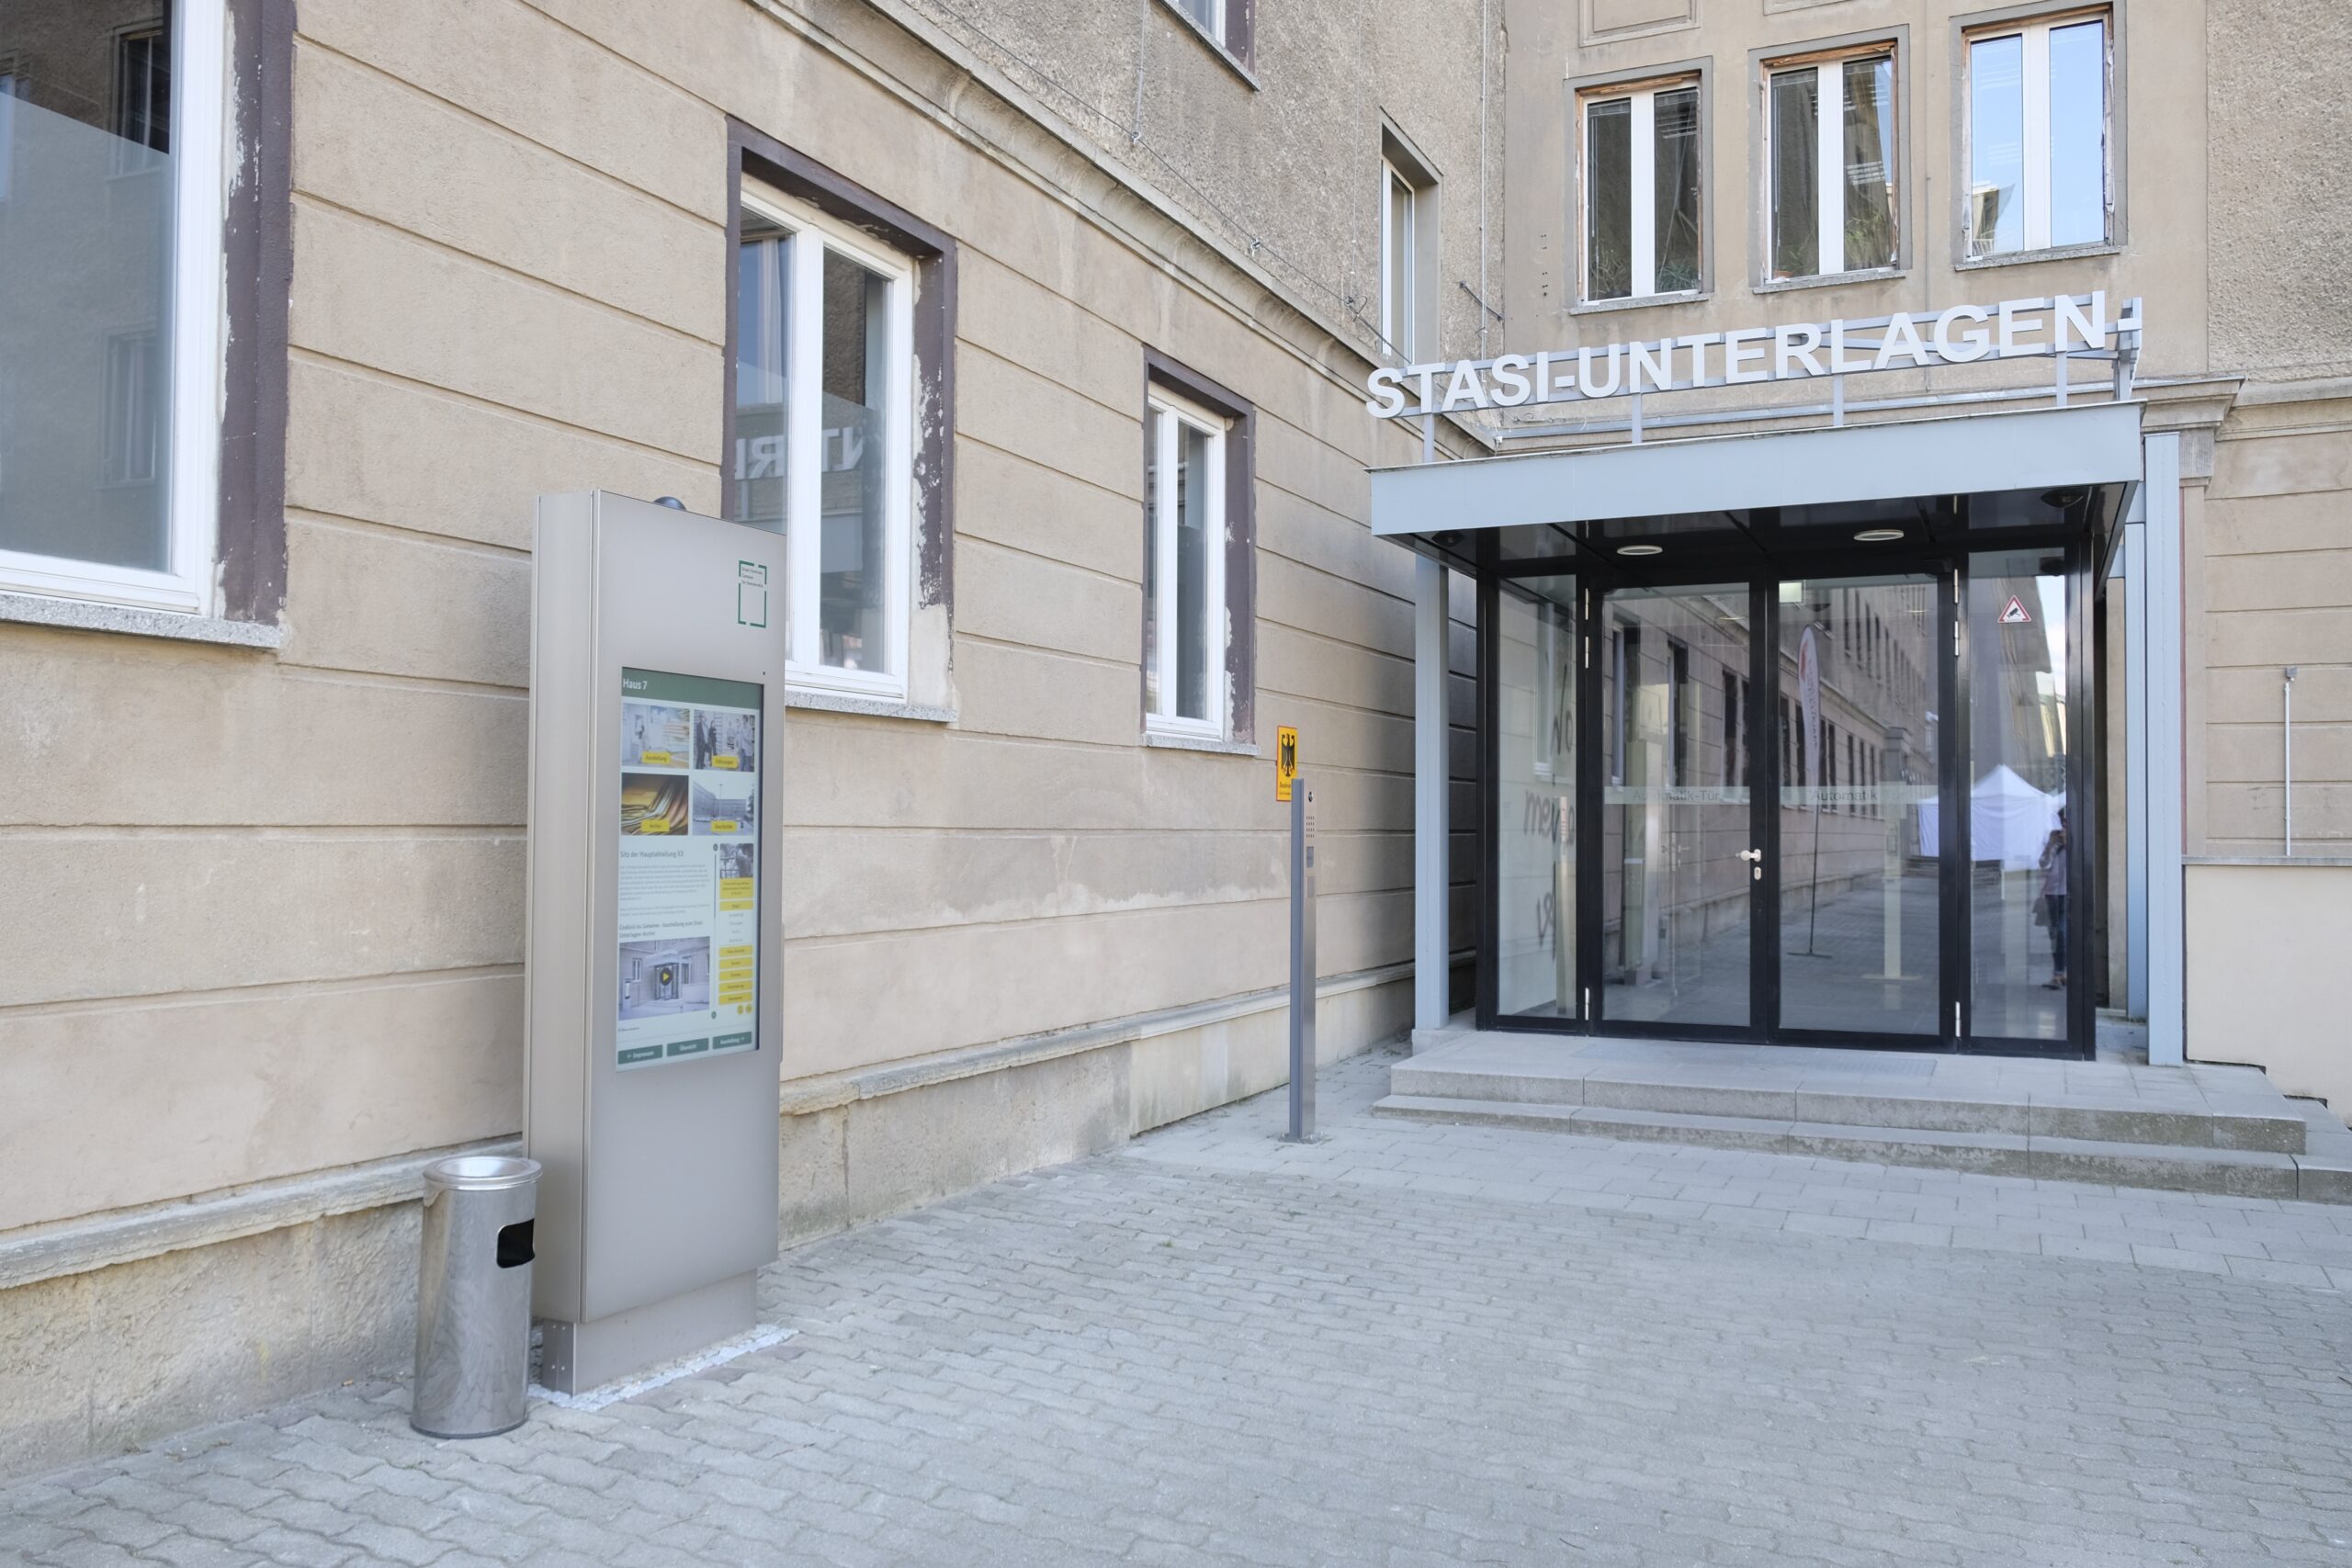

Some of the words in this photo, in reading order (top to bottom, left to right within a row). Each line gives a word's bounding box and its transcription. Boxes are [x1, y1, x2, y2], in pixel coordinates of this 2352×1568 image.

[1365, 289, 2143, 420] STASI-UNTERLAGEN-
[623, 678, 641, 690] Haus
[642, 681, 648, 690] 7
